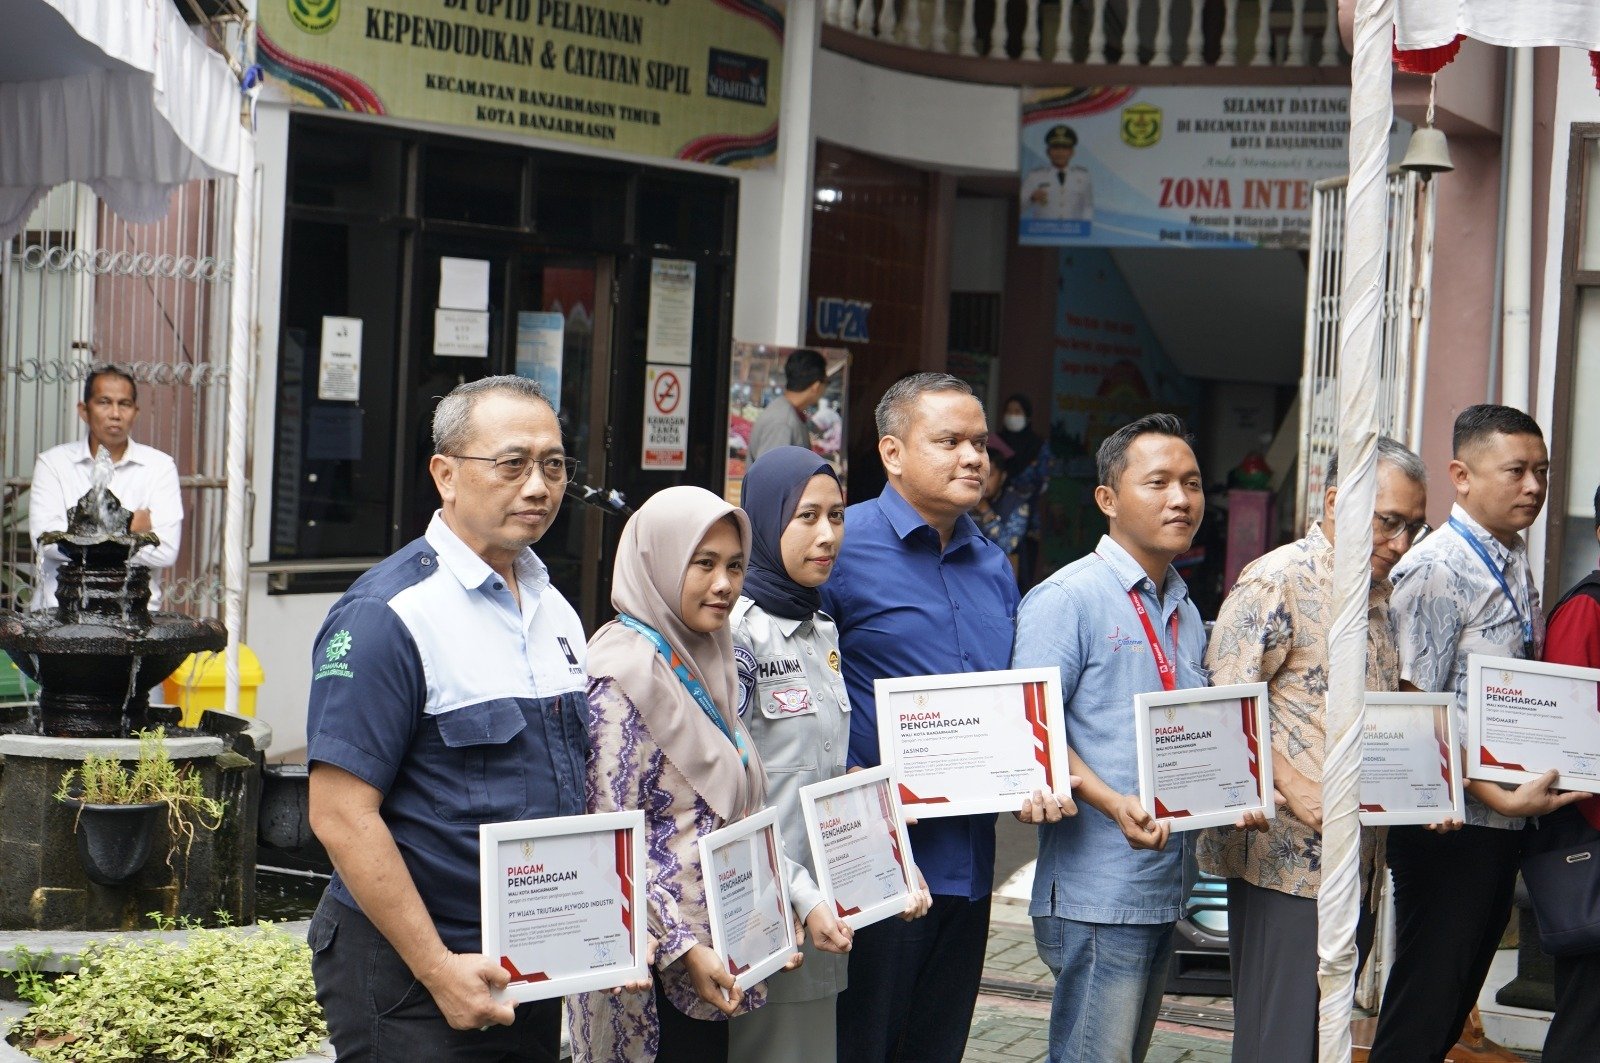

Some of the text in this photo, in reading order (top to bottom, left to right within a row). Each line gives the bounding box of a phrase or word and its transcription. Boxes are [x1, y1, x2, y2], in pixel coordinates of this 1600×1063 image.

[537, 0, 643, 45] PELAYANAN
[365, 7, 534, 66] KEPENDUDUKAN
[540, 39, 556, 70] &
[564, 44, 641, 86] CATATAN
[645, 60, 692, 95] SIPIL
[425, 73, 661, 126] KECAMATAN BANJARMASIN TIMUR
[1223, 97, 1348, 114] SELAMAT DATANG
[476, 105, 616, 141] KOTA BANJARMASIN
[1177, 119, 1190, 133] DI
[1194, 119, 1266, 133] KECAMATAN
[1231, 137, 1343, 150] KOTA BANJARMASIN
[1158, 177, 1315, 210] ZONA INTE
[1486, 686, 1522, 696] PIAGAM
[1486, 694, 1557, 707] PENGHARGAAN
[900, 712, 941, 722] PIAGAM
[900, 717, 980, 731] PENGHARGAAN
[1155, 725, 1184, 735] PIAGAM
[1363, 731, 1404, 740] GHARGAAN
[1155, 731, 1212, 744] PENGHARGAAN
[820, 817, 841, 831] PIAGAM
[822, 820, 861, 840] PENGHARGAAN
[507, 863, 544, 877] PIAGAM
[718, 868, 736, 882] PIAGAM
[508, 870, 578, 888] PENGHARGAAN
[720, 870, 753, 893] PENGHARGAAN
[517, 909, 536, 917] WIJAYA
[537, 906, 563, 915] TRIUTAMA
[564, 902, 590, 911] PLYWOOD
[590, 898, 614, 908] INDUSTRI
